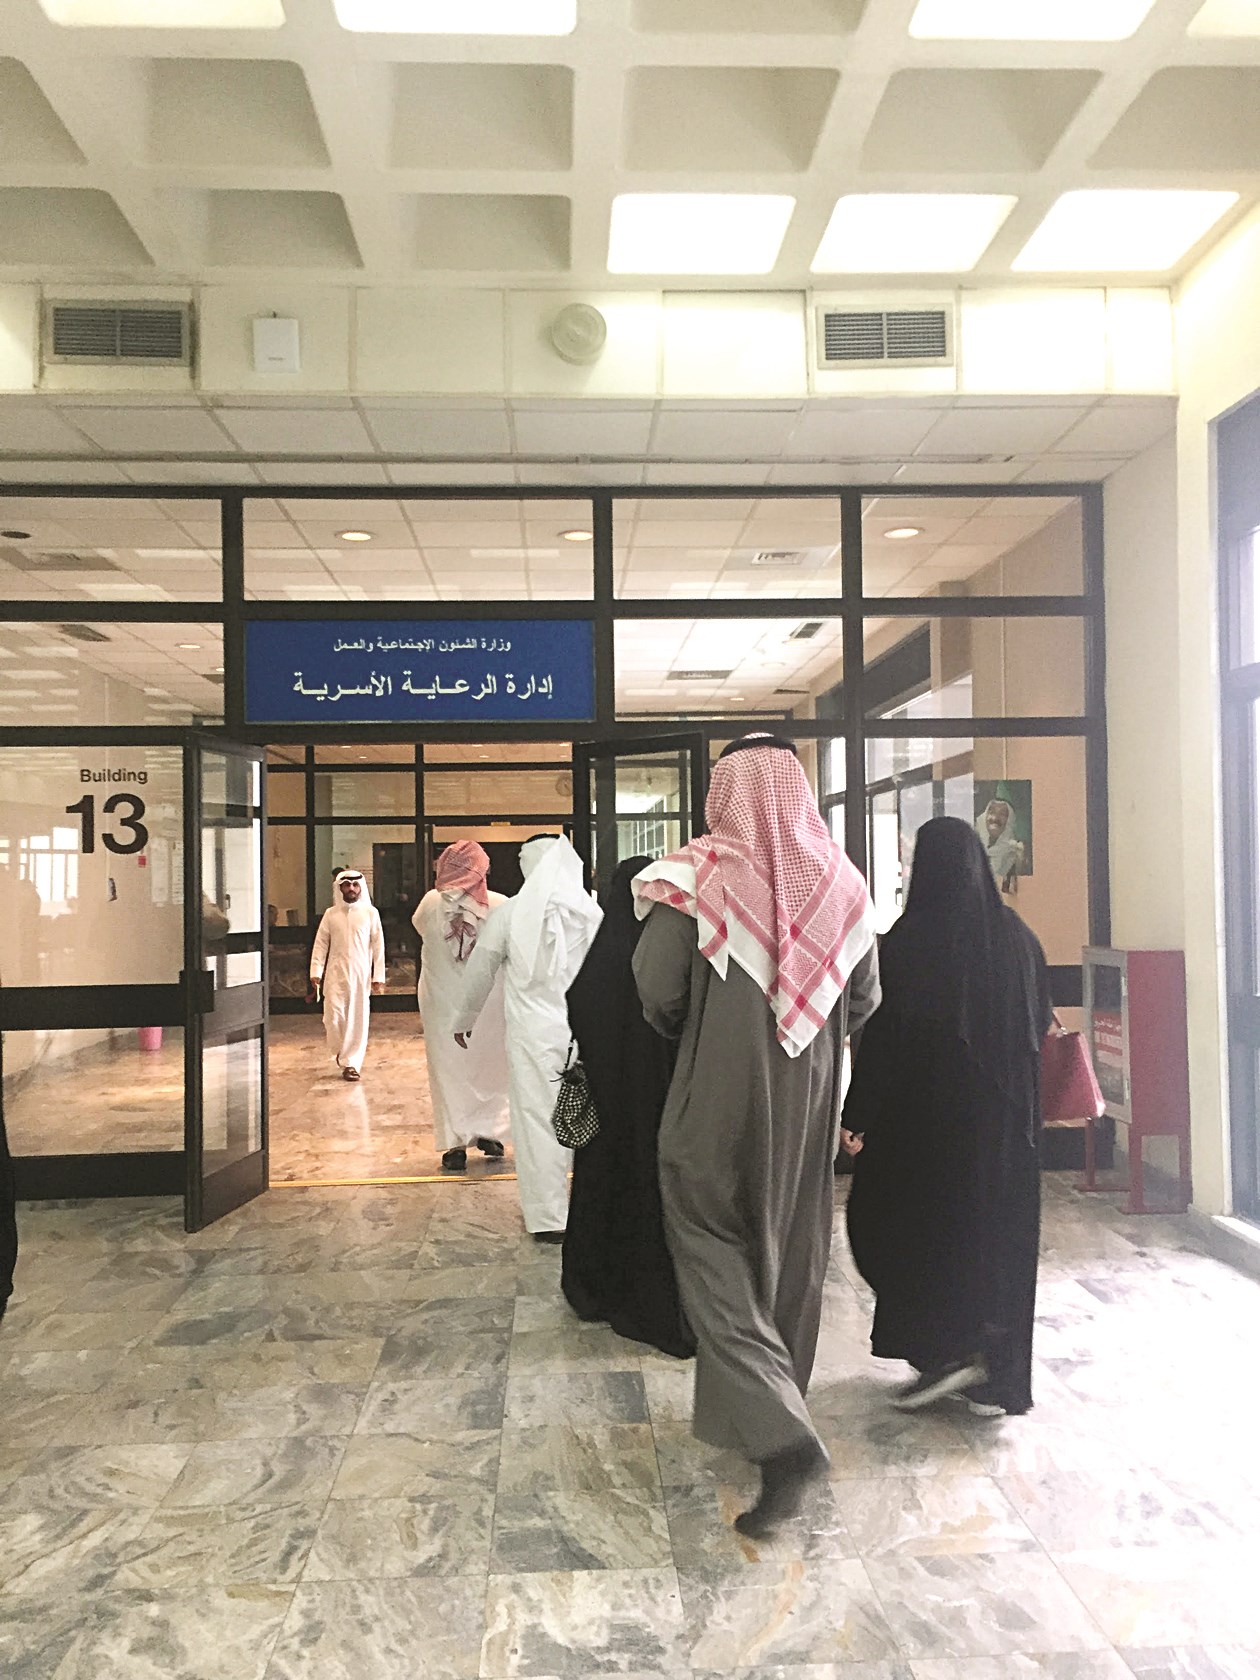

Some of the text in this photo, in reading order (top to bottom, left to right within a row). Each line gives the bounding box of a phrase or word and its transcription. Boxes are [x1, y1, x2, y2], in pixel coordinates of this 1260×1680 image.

[333, 638, 374, 652] والعمل
[481, 637, 512, 652] وزارة
[292, 670, 553, 702] إدارة الرعاية الأسرية
[80, 768, 149, 785] Building
[65, 792, 149, 855] 13
